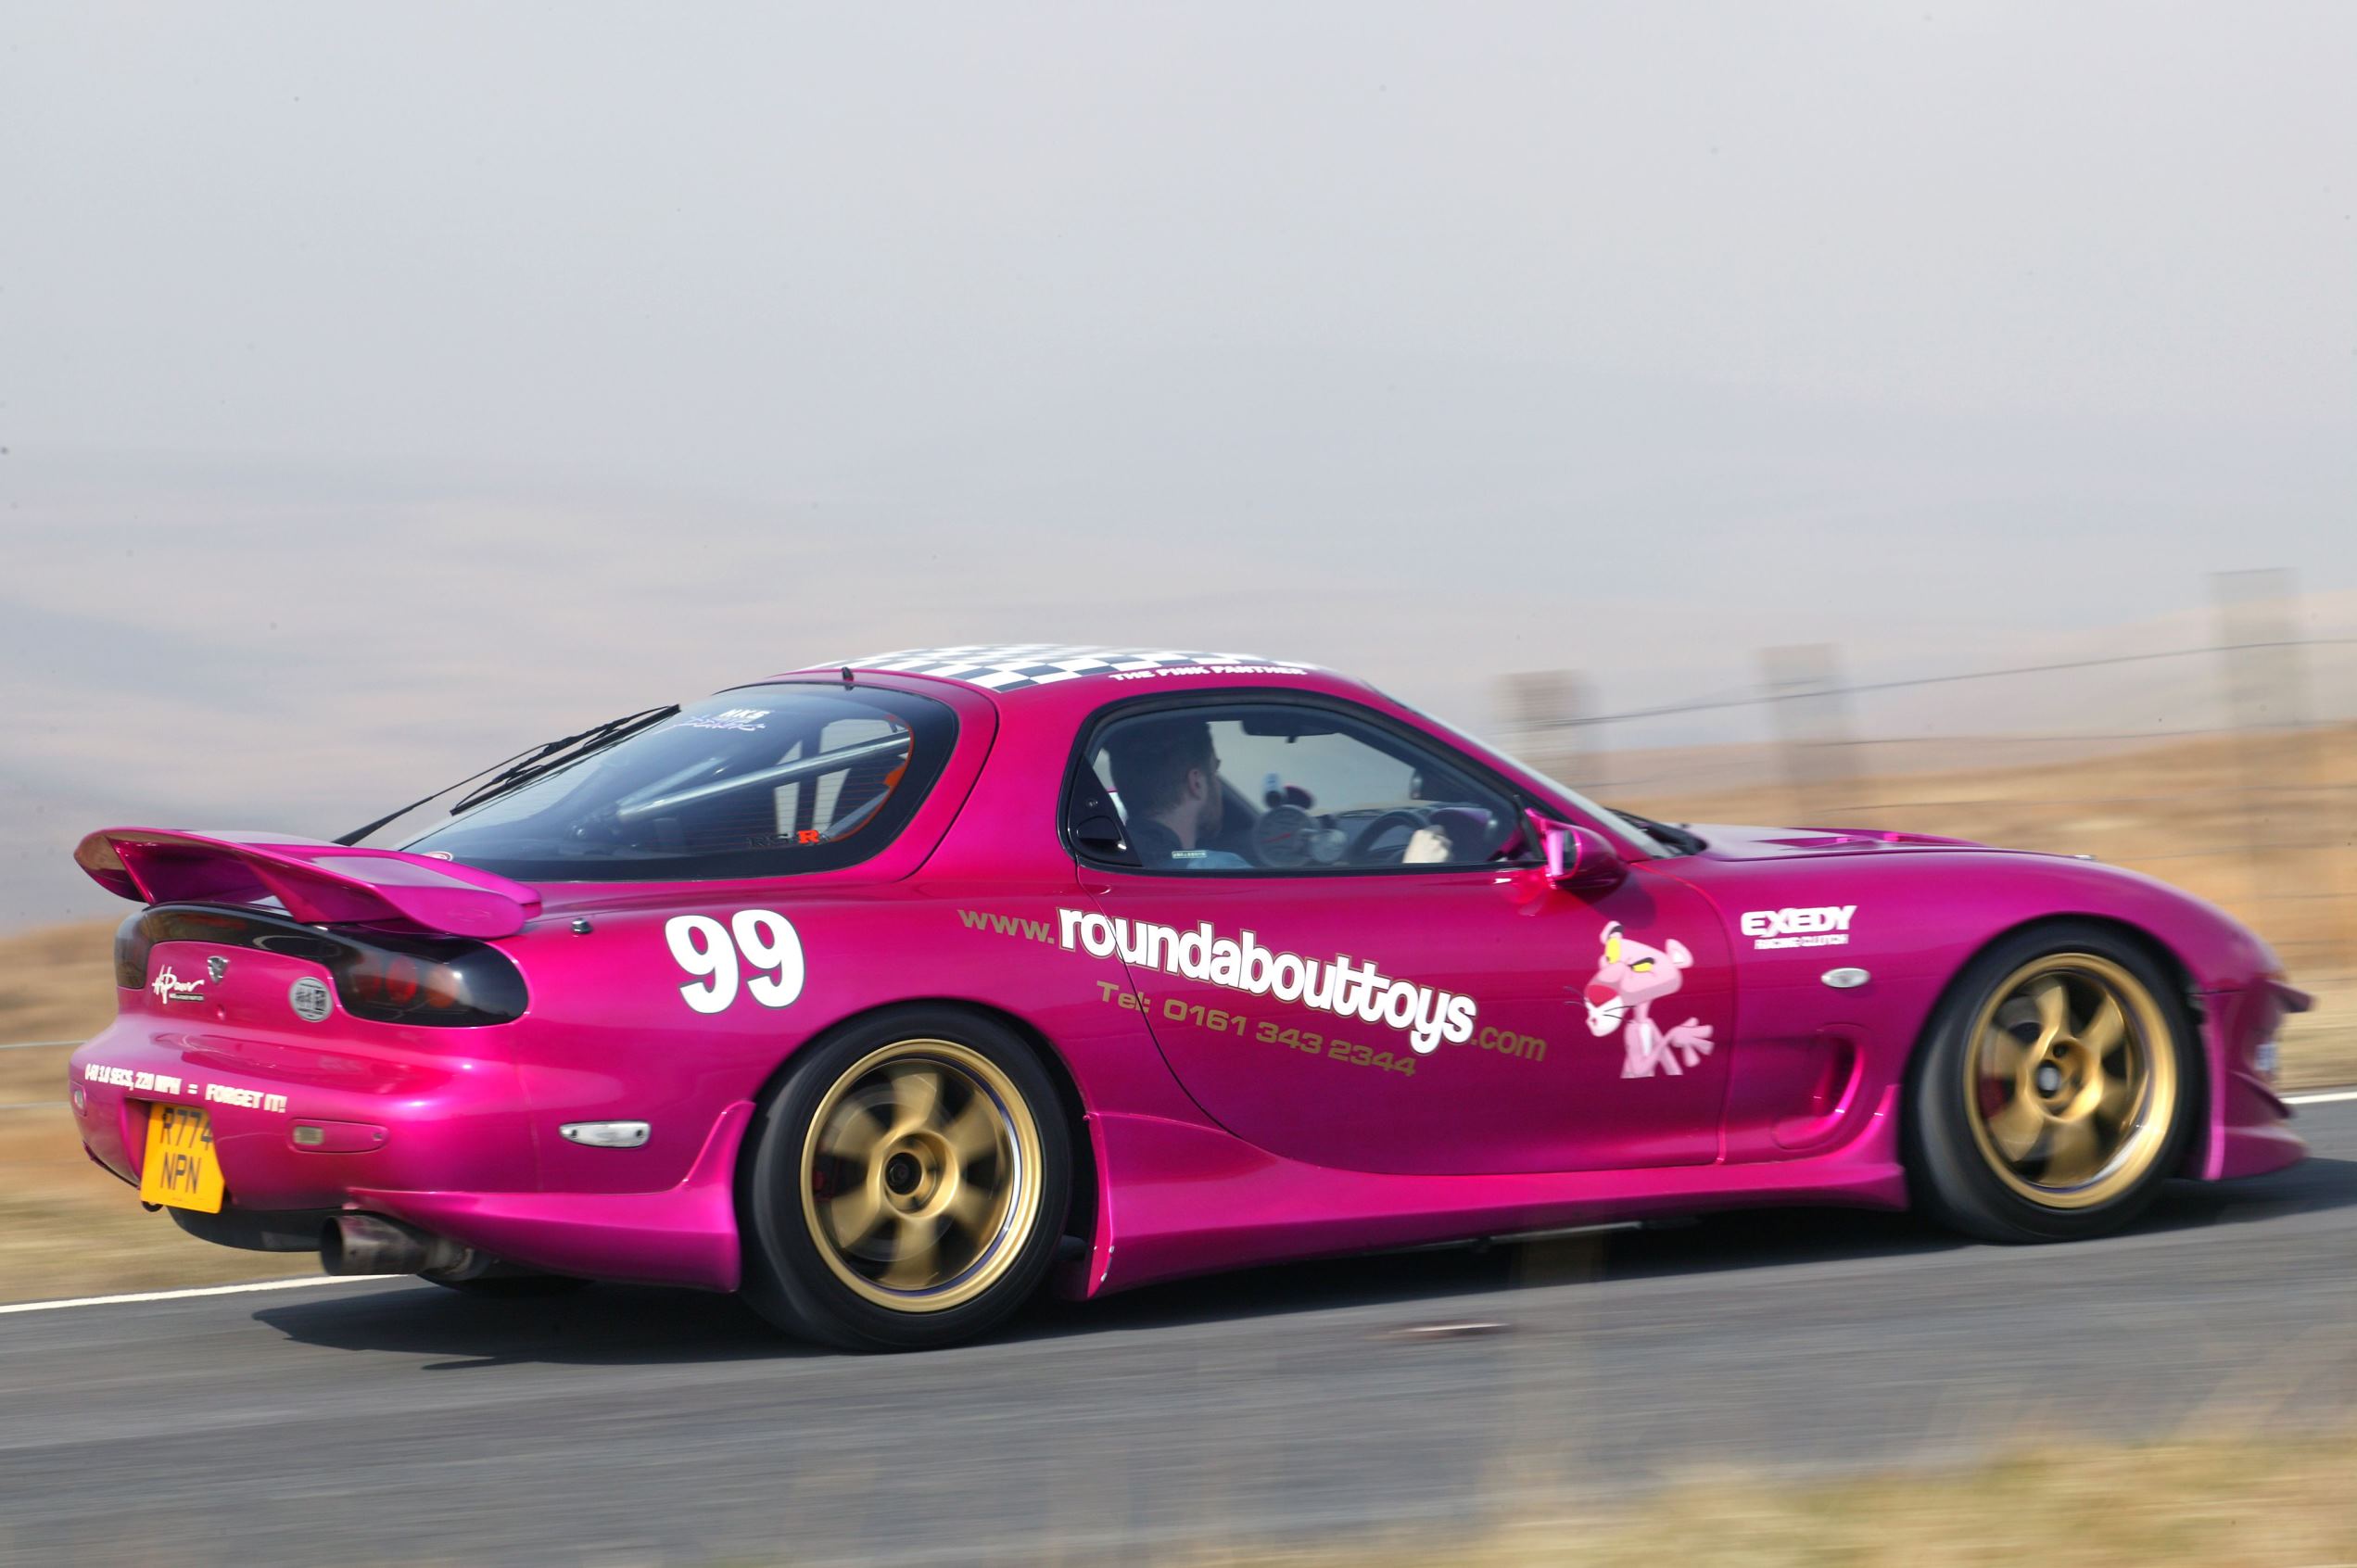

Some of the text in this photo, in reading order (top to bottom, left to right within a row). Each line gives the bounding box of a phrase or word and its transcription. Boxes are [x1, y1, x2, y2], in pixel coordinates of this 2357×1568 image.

[1741, 904, 1858, 938] EXEDY
[664, 908, 806, 1015] 99
[1096, 980, 1417, 1078] Tel: 0161 343 2344
[205, 1083, 264, 1109] FORGET
[160, 1106, 212, 1151] R774
[159, 1151, 202, 1195] NPN
